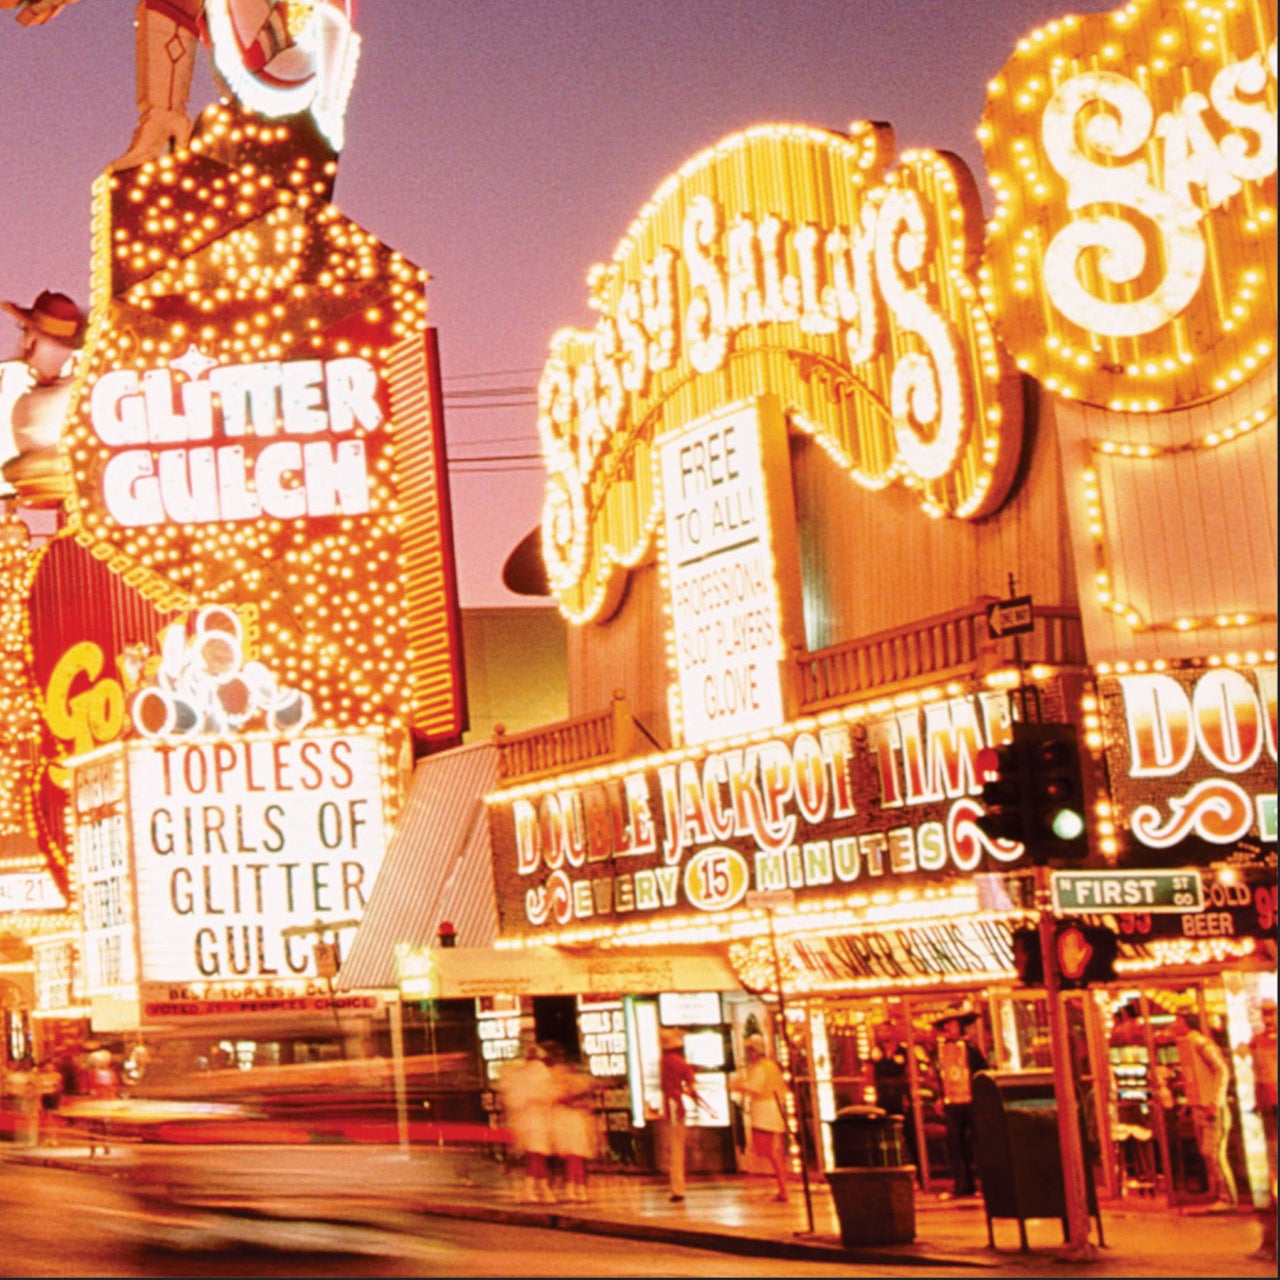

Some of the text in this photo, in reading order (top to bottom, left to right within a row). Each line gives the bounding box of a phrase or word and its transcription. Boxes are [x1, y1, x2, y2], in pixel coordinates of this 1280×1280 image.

[1042, 44, 1278, 337] SAS
[103, 440, 369, 526] GULCH
[679, 425, 739, 500] FREE
[675, 507, 702, 548] TO
[703, 663, 760, 721] GLOVE
[153, 739, 354, 797] TOPLESS
[150, 803, 286, 856] GIRLS
[318, 798, 368, 850] OF
[513, 772, 657, 875] DOUBLE
[659, 724, 857, 865] JACKPOT
[169, 861, 368, 916] GLITTER
[573, 821, 948, 918] EVERY 15 MINUTES
[1075, 879, 1157, 905] FIRST
[1172, 877, 1189, 890] ST
[194, 925, 341, 977] GULC
[1181, 912, 1234, 936] BEER
